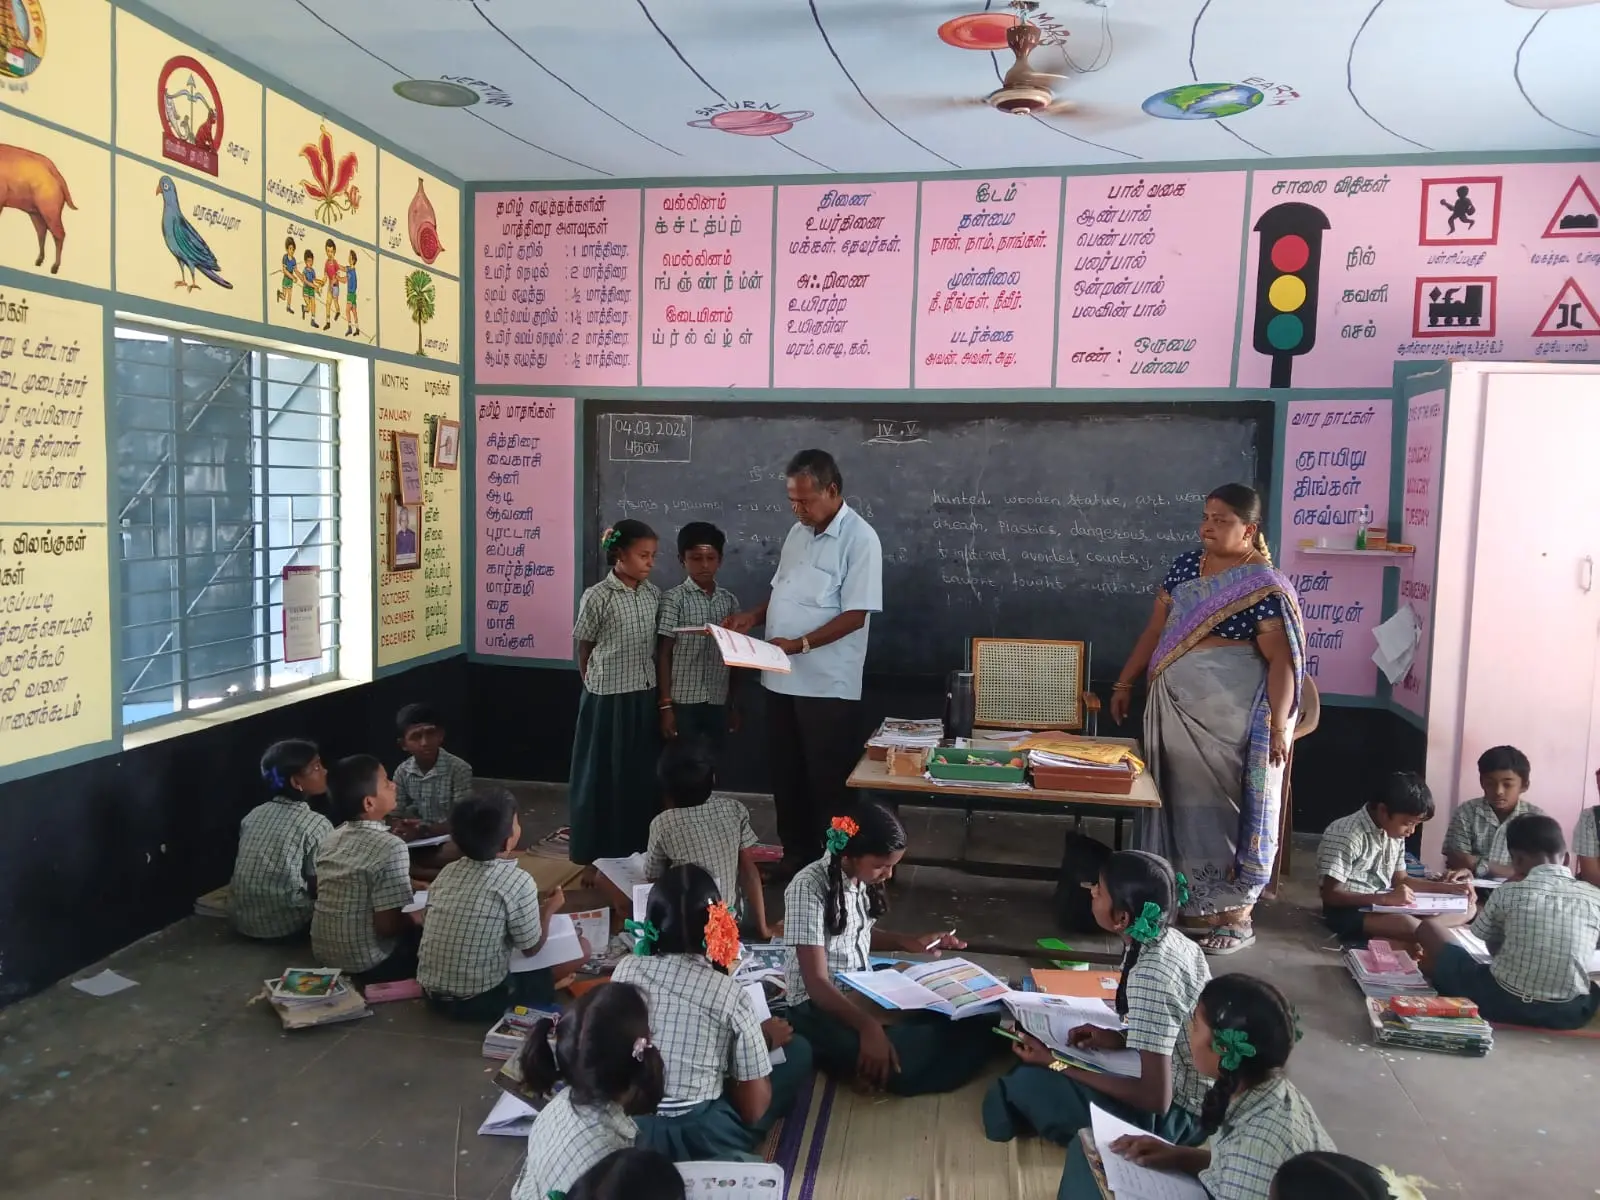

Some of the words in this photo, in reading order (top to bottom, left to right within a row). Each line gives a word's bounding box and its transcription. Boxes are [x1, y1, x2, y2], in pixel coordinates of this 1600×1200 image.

[696, 100, 782, 119] SATURN
[975, 182, 1018, 203] இடம்
[1107, 178, 1144, 200] பால்
[1145, 181, 1187, 199] வகை
[1271, 178, 1328, 195] சாலை
[1333, 174, 1391, 198] விதிகள்
[496, 197, 522, 217] தமிழ்
[529, 195, 606, 216] எழுத்துக்களின்
[663, 192, 727, 211] வல்லினம்
[817, 189, 872, 212] திணை
[502, 219, 551, 239] மாத்திரை
[556, 218, 608, 238] அளவுகள்
[806, 213, 885, 234] உயர்திணை
[957, 208, 1016, 231] தன்மை
[484, 242, 514, 261] உயிர்
[516, 241, 543, 261] குறில்
[662, 249, 732, 267] மெல்லினம்
[1346, 245, 1376, 272] நில்
[484, 263, 512, 282] உயிர்
[516, 262, 549, 283] நெடில்
[947, 267, 1021, 290] முன்னிலை
[484, 284, 507, 302] மெய்
[511, 285, 546, 304] எழுத்து
[787, 293, 848, 313] உயிரற்ற
[1341, 283, 1389, 303] கவனி
[485, 307, 510, 326] உயிர்
[510, 307, 531, 323] மெய்
[532, 306, 559, 328] குறில்
[665, 306, 733, 323] இடையினம்
[787, 315, 848, 336] உயிருள்ள
[1340, 320, 1377, 339] செல்
[485, 328, 512, 348] உயிர்
[514, 329, 534, 344] மெய்
[536, 328, 564, 348] நெடில்
[950, 325, 1015, 347] படர்க்கை
[1134, 336, 1197, 353] ஒருமை
[22, 336, 81, 364] உண்டான்
[484, 349, 510, 368] ஆய்த
[513, 349, 548, 367] எழுத்து
[1130, 358, 1189, 375] பன்மை
[21, 371, 88, 399] முடைந்தார்
[380, 373, 409, 391] MONTHS
[14, 400, 84, 429] எழுப்பினார்
[379, 407, 412, 421] JANUARY
[479, 401, 501, 420] தமிழ்
[506, 402, 556, 422] மாதங்கள்
[1292, 410, 1321, 427] வார
[1321, 406, 1376, 429] நாட்கள்
[486, 431, 540, 451] சித்திரை
[487, 453, 541, 468] வைகாசி
[1295, 446, 1367, 471] ஞாயிறு
[22, 464, 87, 491] பருகினான்
[486, 490, 514, 506] ஆடி
[1293, 475, 1361, 501] திங்கள்
[486, 507, 533, 521] ஆவணி
[13, 529, 87, 556] விலங்குகள்
[486, 526, 541, 541] புரட்டாசி
[486, 560, 555, 580] கார்த்திகை
[486, 578, 535, 596] மார்கழி
[381, 591, 410, 606] OCTOBER
[487, 599, 509, 614] தை
[382, 610, 415, 626] NOVEMBER
[487, 615, 515, 631] மாசி
[485, 632, 535, 650] பங்குனி
